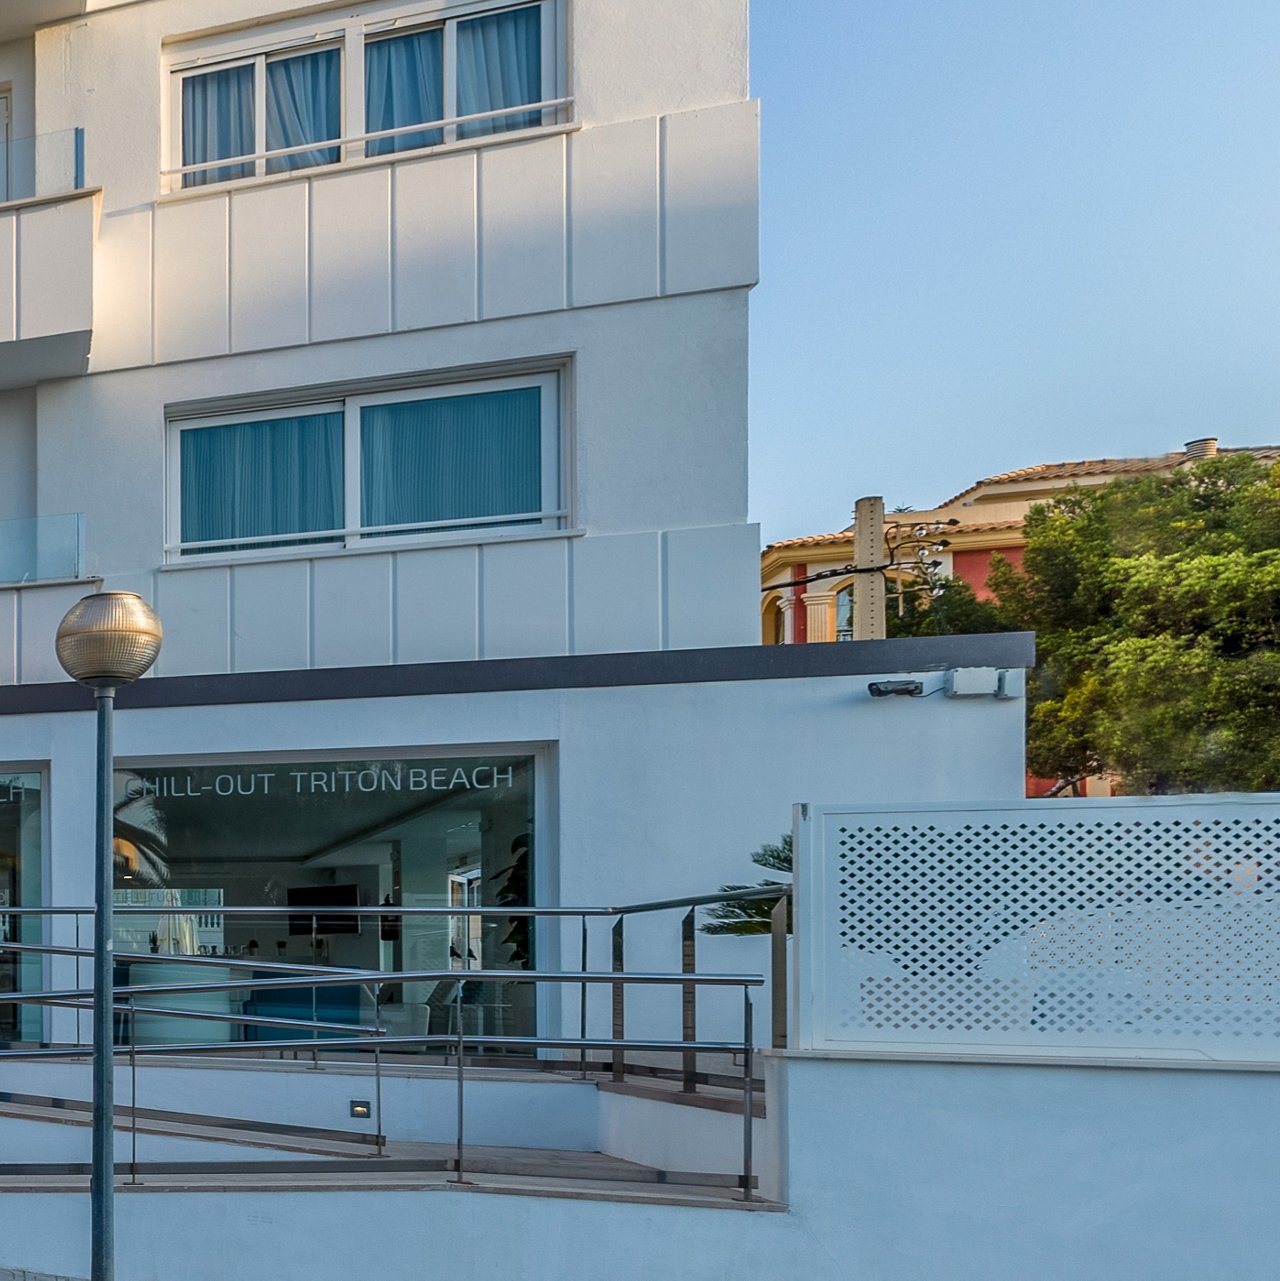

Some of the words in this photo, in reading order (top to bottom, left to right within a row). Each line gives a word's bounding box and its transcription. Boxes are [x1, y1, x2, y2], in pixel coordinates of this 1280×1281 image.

[121, 771, 276, 799] CHILL-OUT
[290, 766, 401, 794] TRITON
[409, 764, 513, 791] BEACH
